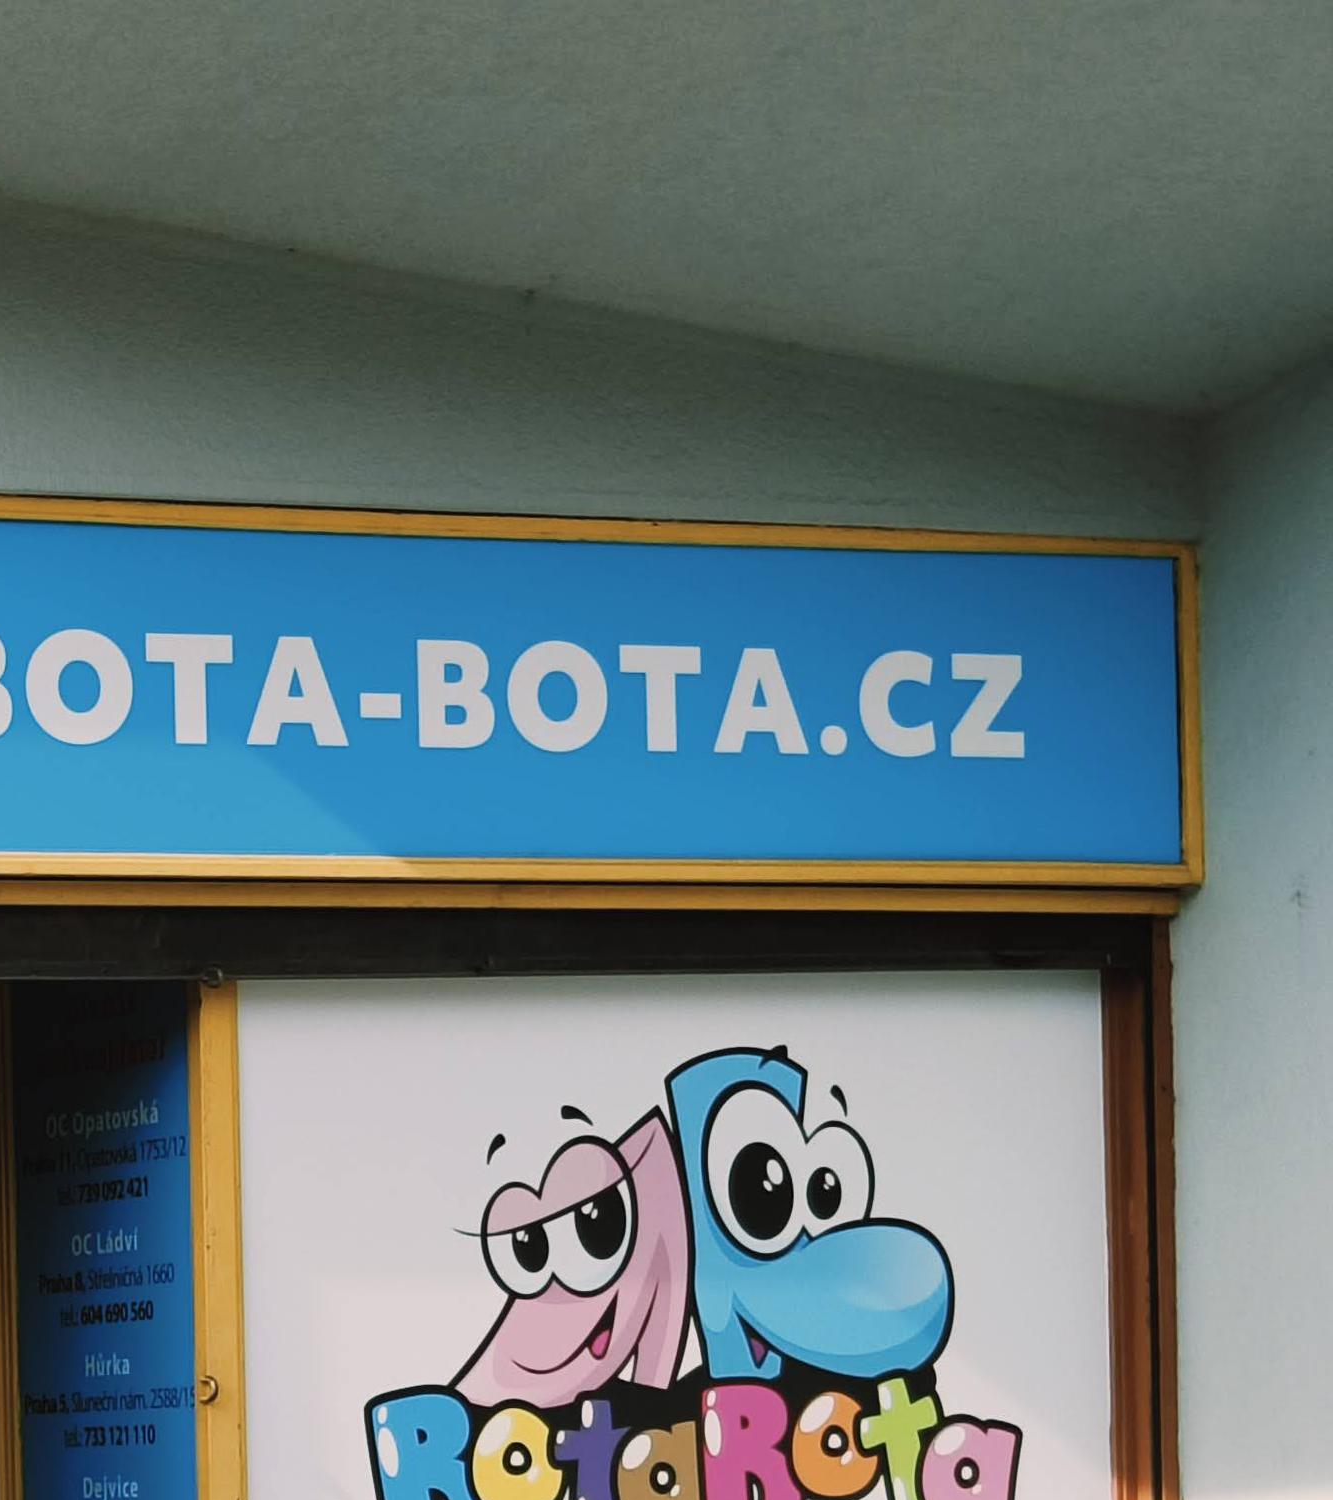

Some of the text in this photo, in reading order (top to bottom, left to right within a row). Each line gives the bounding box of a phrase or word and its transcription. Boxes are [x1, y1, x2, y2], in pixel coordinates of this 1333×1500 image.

[71, 1098, 160, 1140] Opatovská
[77, 1182, 101, 1204] 739
[101, 1179, 123, 1201] 092
[126, 1176, 149, 1198] 421
[71, 1226, 138, 1256] OC Ládví
[38, 1273, 75, 1296] Praha
[146, 1262, 175, 1284] 1660
[80, 1304, 103, 1326] 604
[105, 1302, 129, 1324] 690
[130, 1300, 154, 1321] 560
[84, 1352, 131, 1378] Hůrka
[83, 1426, 106, 1446] 733
[108, 1425, 130, 1446] 121
[133, 1424, 156, 1445] 110
